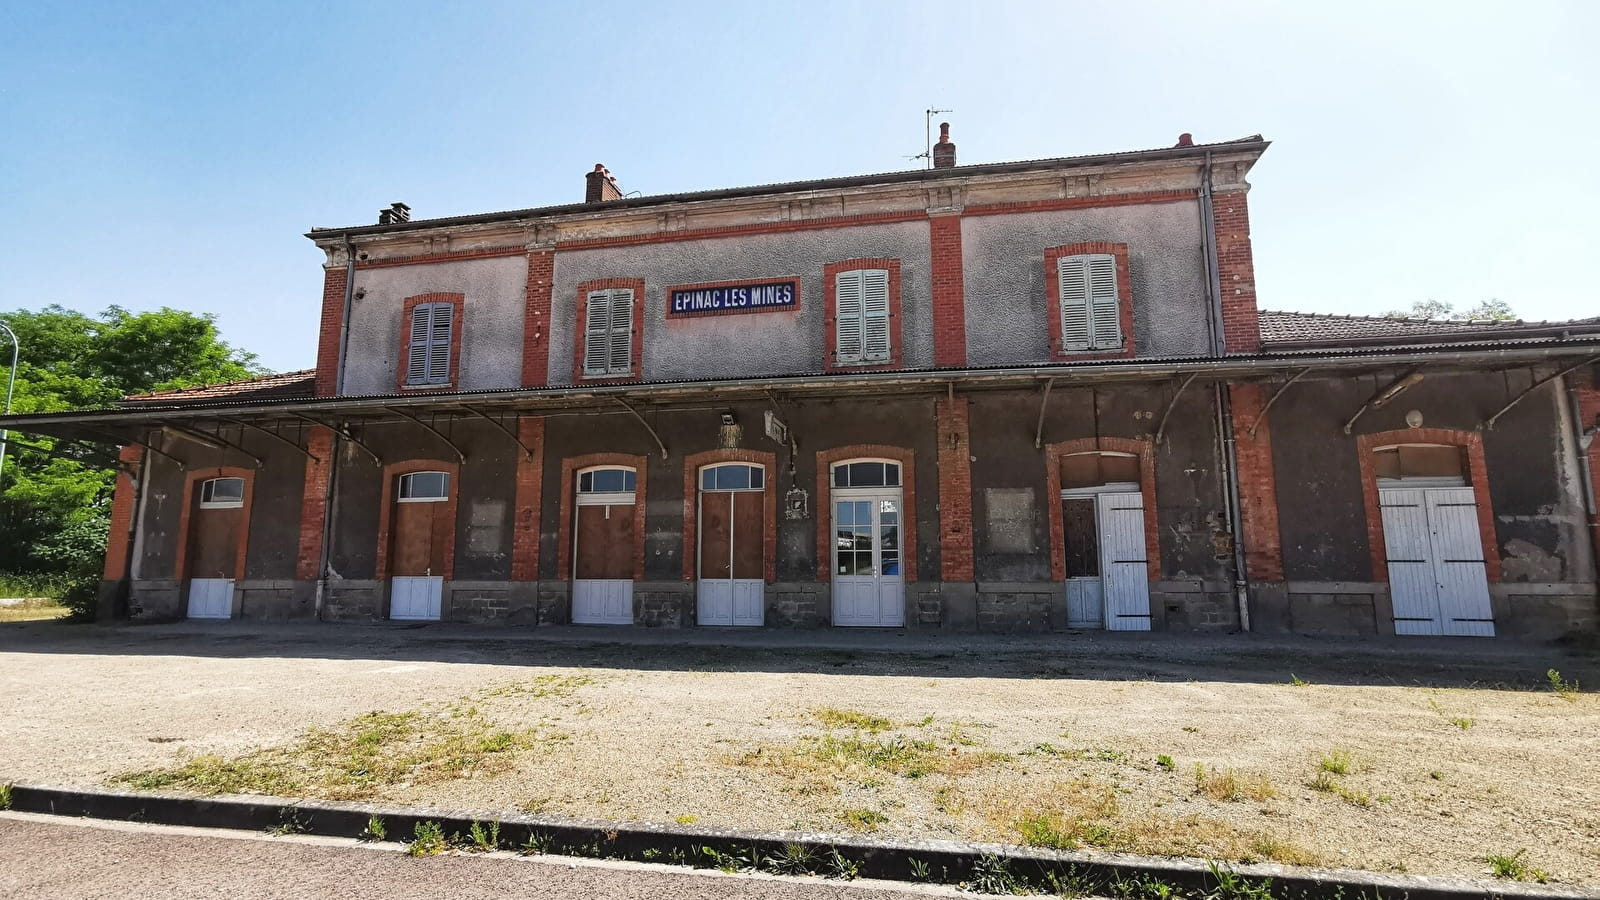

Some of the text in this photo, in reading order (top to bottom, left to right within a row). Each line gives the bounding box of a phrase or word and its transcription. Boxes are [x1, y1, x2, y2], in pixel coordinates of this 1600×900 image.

[675, 285, 791, 311] EPINAC LES MINES
